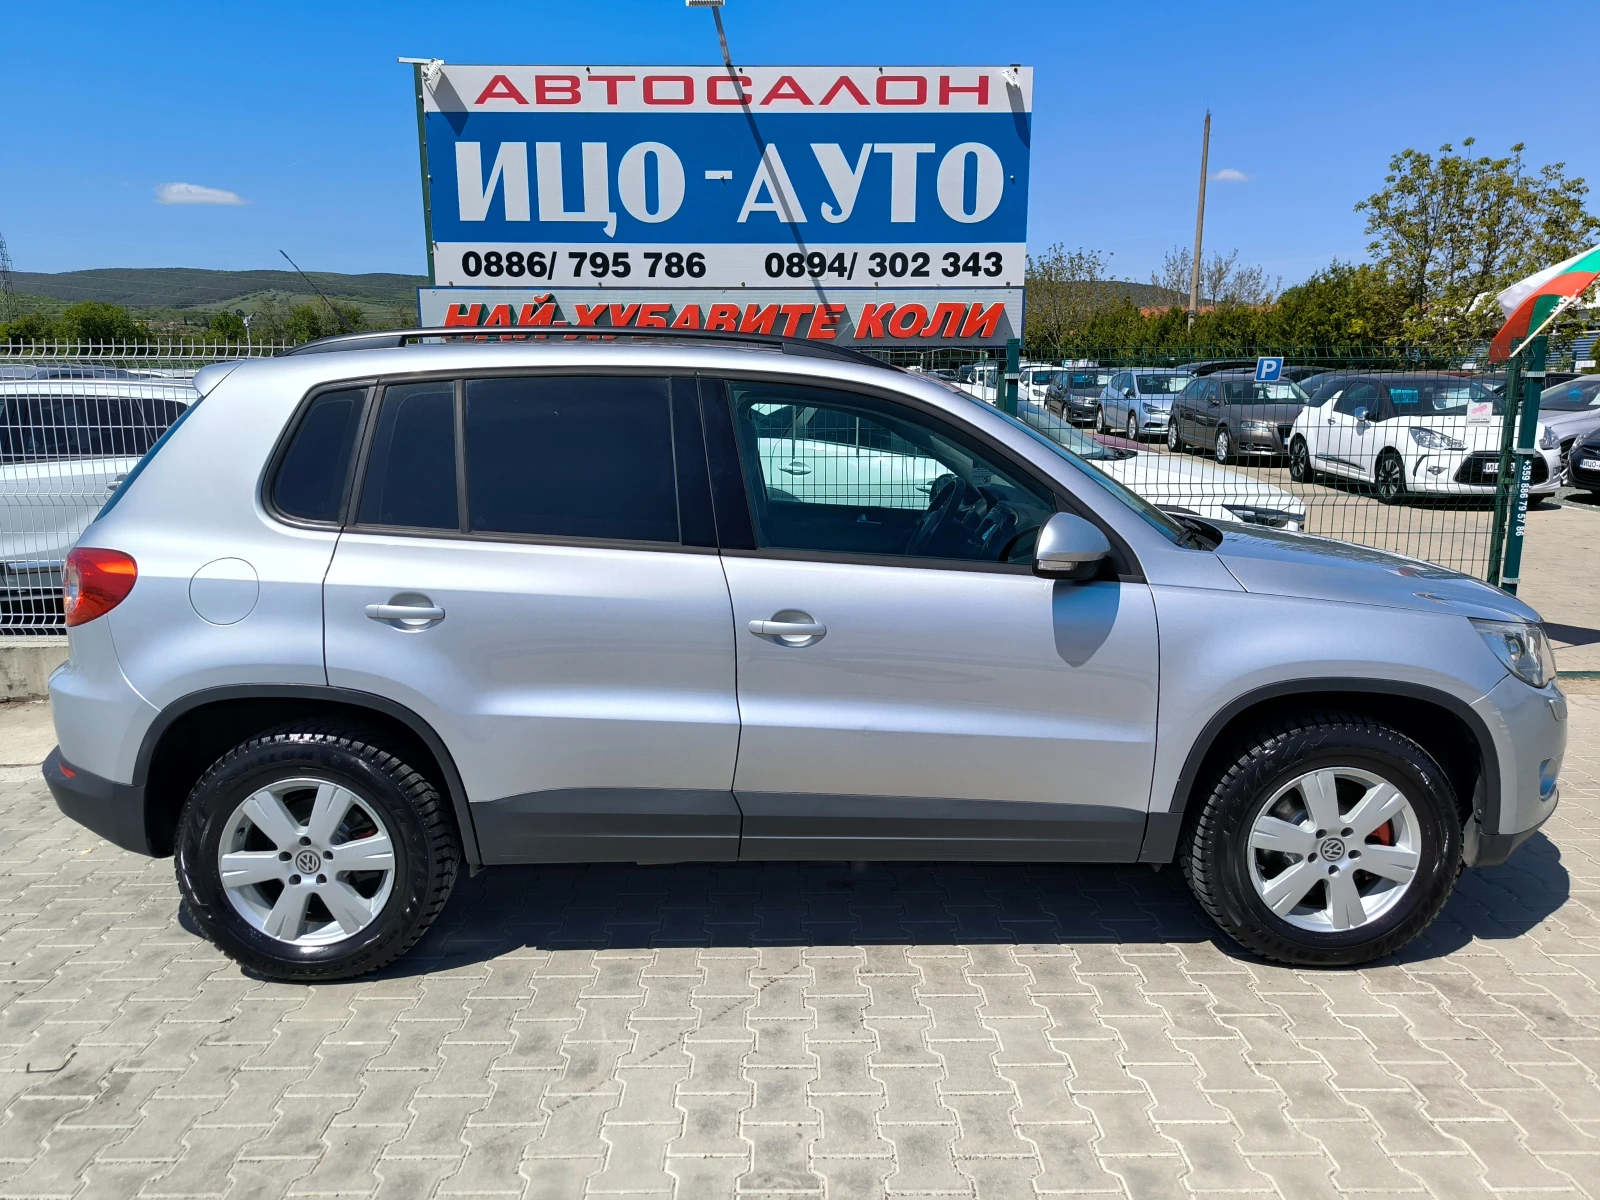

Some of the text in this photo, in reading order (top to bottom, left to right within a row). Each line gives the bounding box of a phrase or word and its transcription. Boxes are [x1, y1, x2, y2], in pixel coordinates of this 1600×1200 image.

[475, 74, 990, 107] АВТОСАЛОН
[461, 250, 707, 281] 0886/ 795 786
[764, 251, 1003, 281] 0894/ 302 343
[854, 301, 1006, 340] КОЛИ
[1260, 360, 1277, 379] P
[1515, 459, 1532, 537] +359 886 79 57 86
